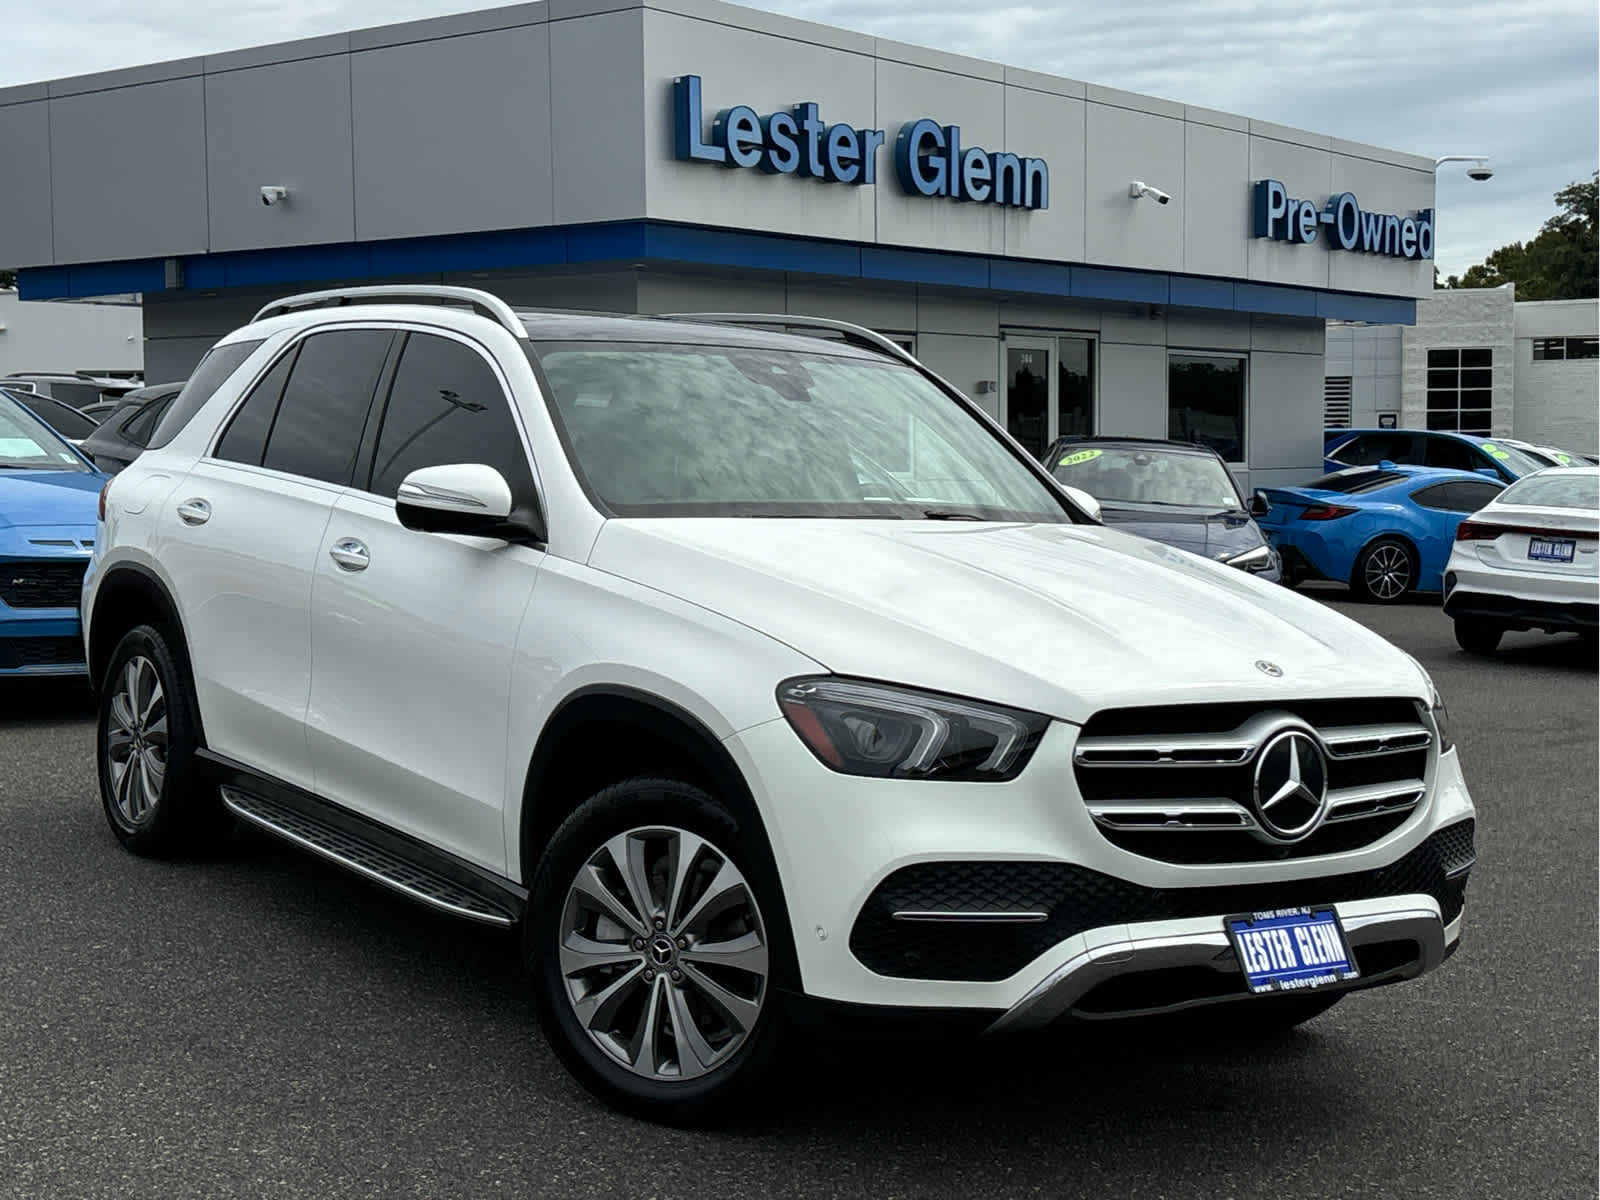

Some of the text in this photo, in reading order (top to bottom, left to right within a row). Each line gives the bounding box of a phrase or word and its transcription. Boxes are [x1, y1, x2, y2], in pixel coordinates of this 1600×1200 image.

[673, 74, 1049, 210] Lester Glenn
[1254, 179, 1435, 260] Pre-Owned
[1065, 450, 1096, 464] 2022
[1530, 541, 1573, 557] LESTER GLENN
[1252, 910, 1275, 920] TOMS
[1301, 905, 1311, 915] NJ
[1236, 923, 1347, 974] LESTER GLENN
[1279, 974, 1337, 990] lesterglenn
